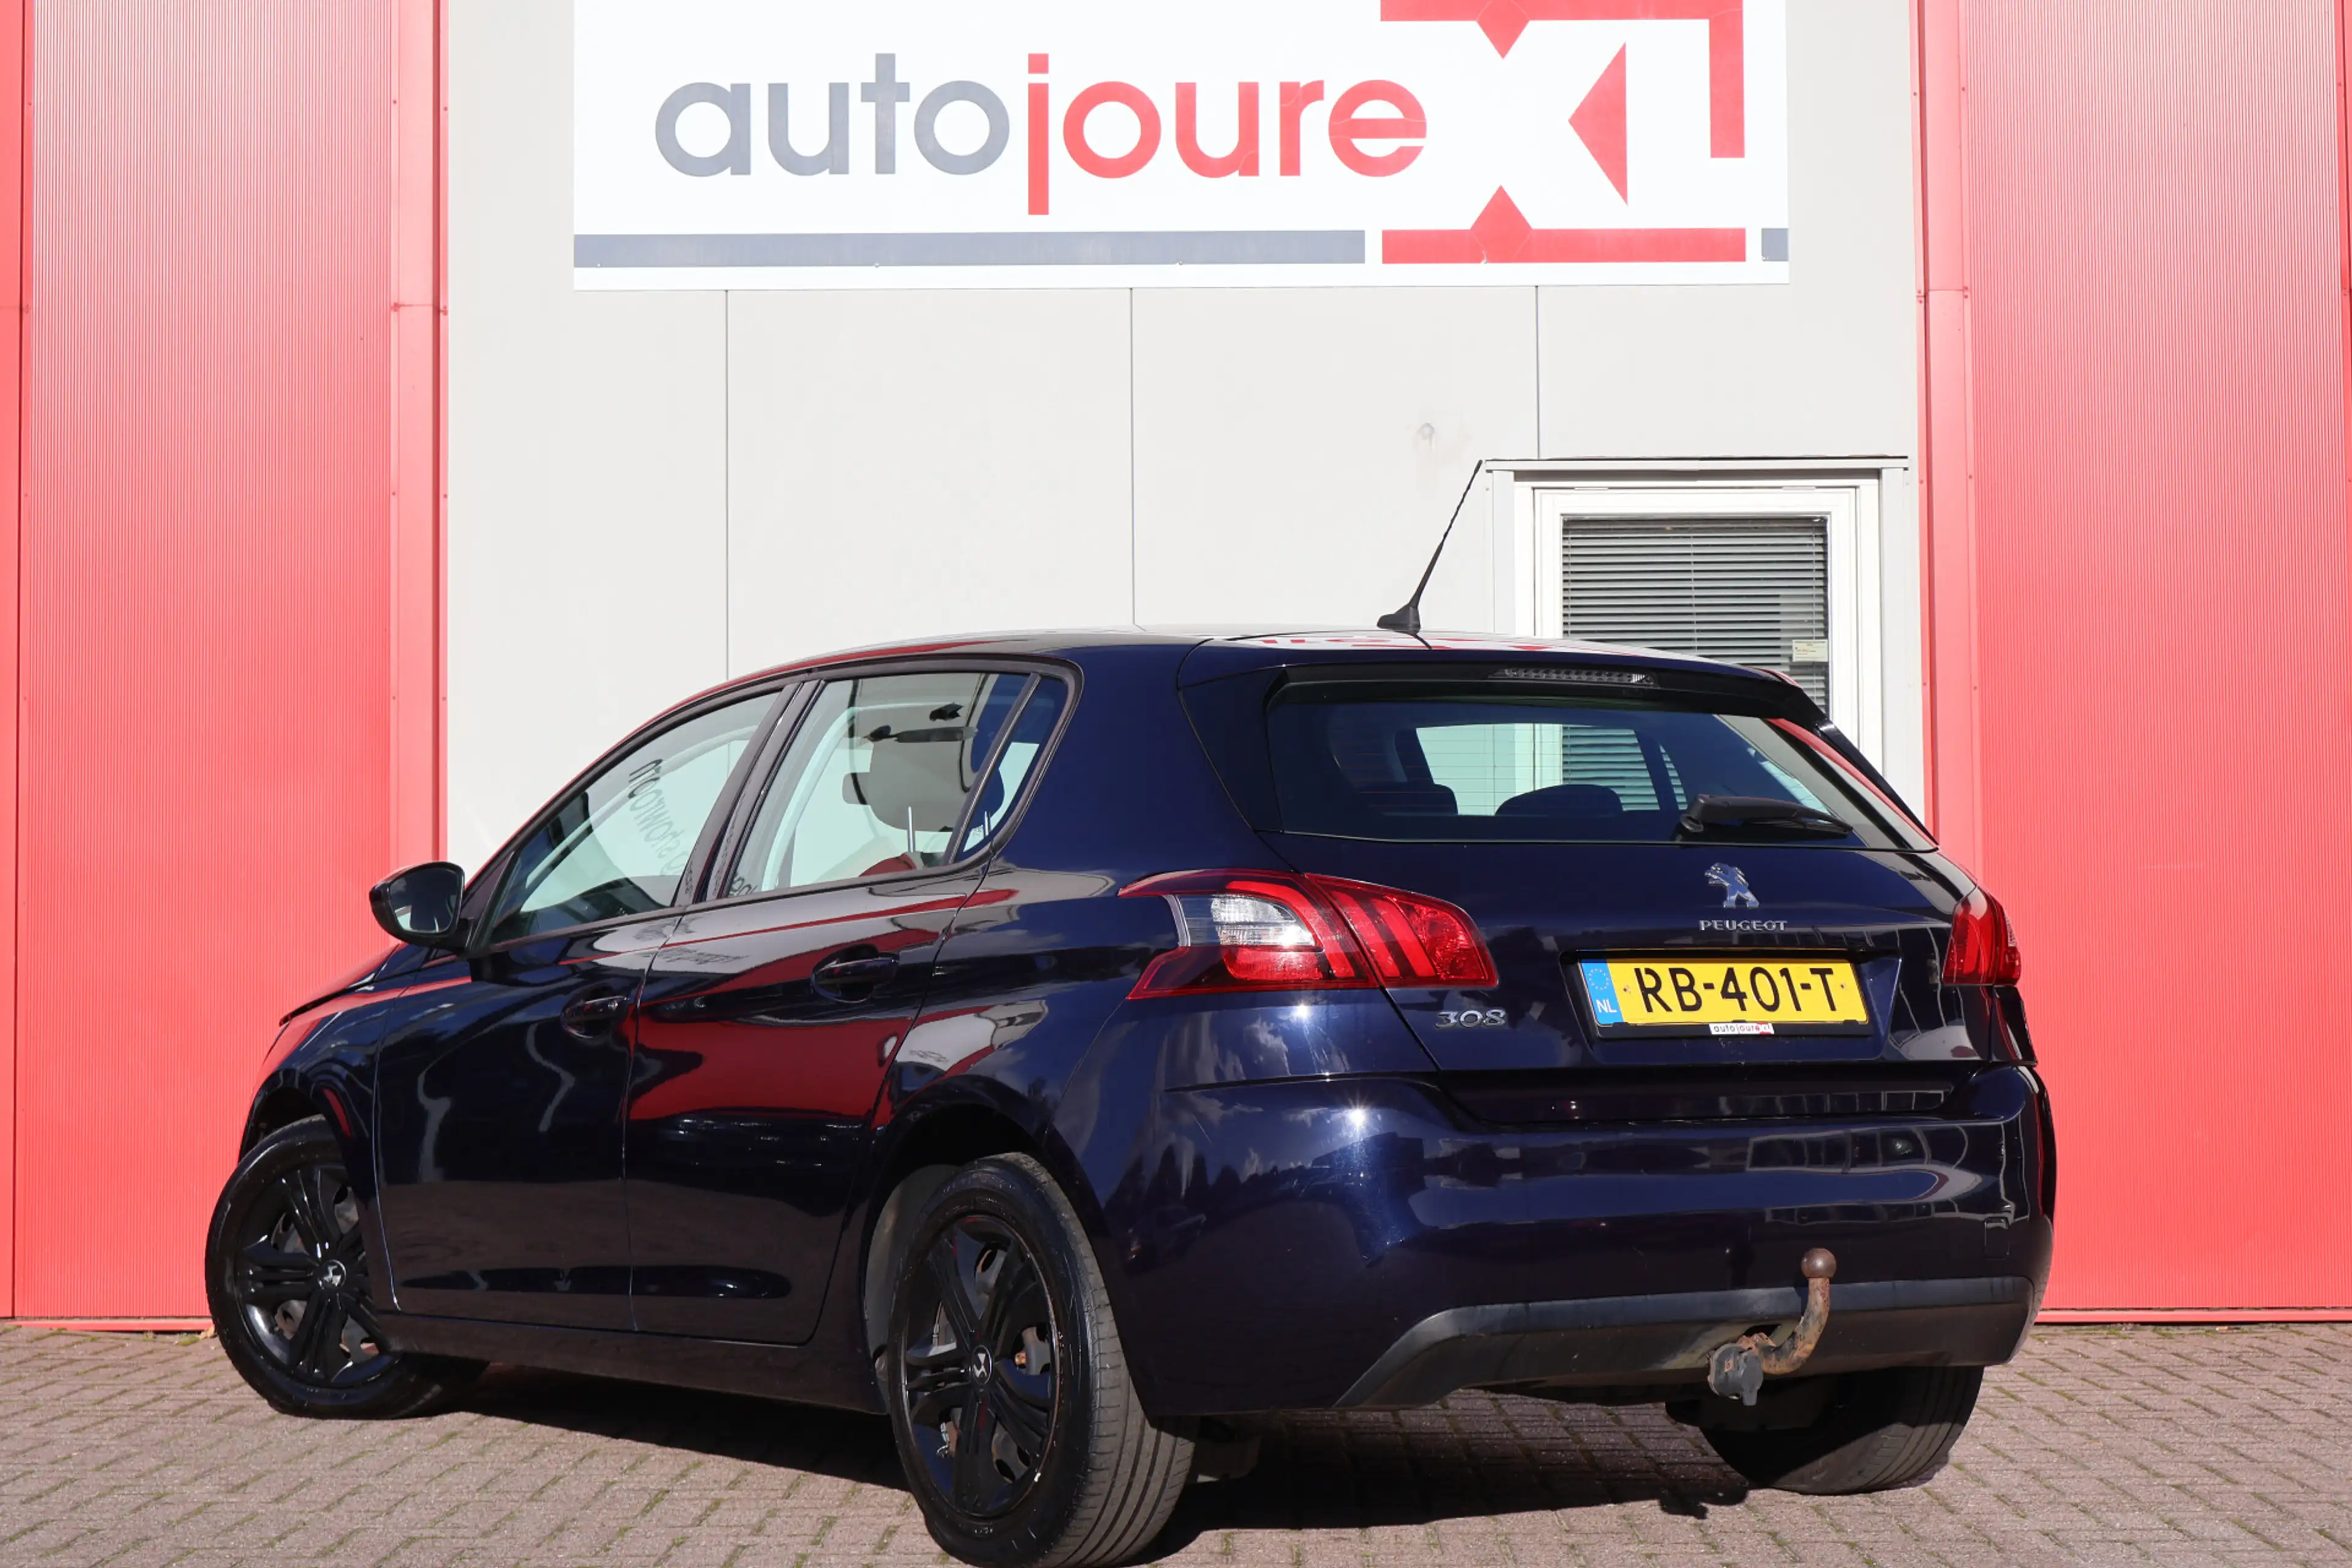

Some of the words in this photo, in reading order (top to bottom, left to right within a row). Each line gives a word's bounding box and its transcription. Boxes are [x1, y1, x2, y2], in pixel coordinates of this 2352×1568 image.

[1698, 919, 1788, 931] PEUGEOT
[1634, 967, 1837, 1012] RB-401-T
[1596, 999, 1617, 1013] NL
[1435, 1009, 1506, 1028] 308
